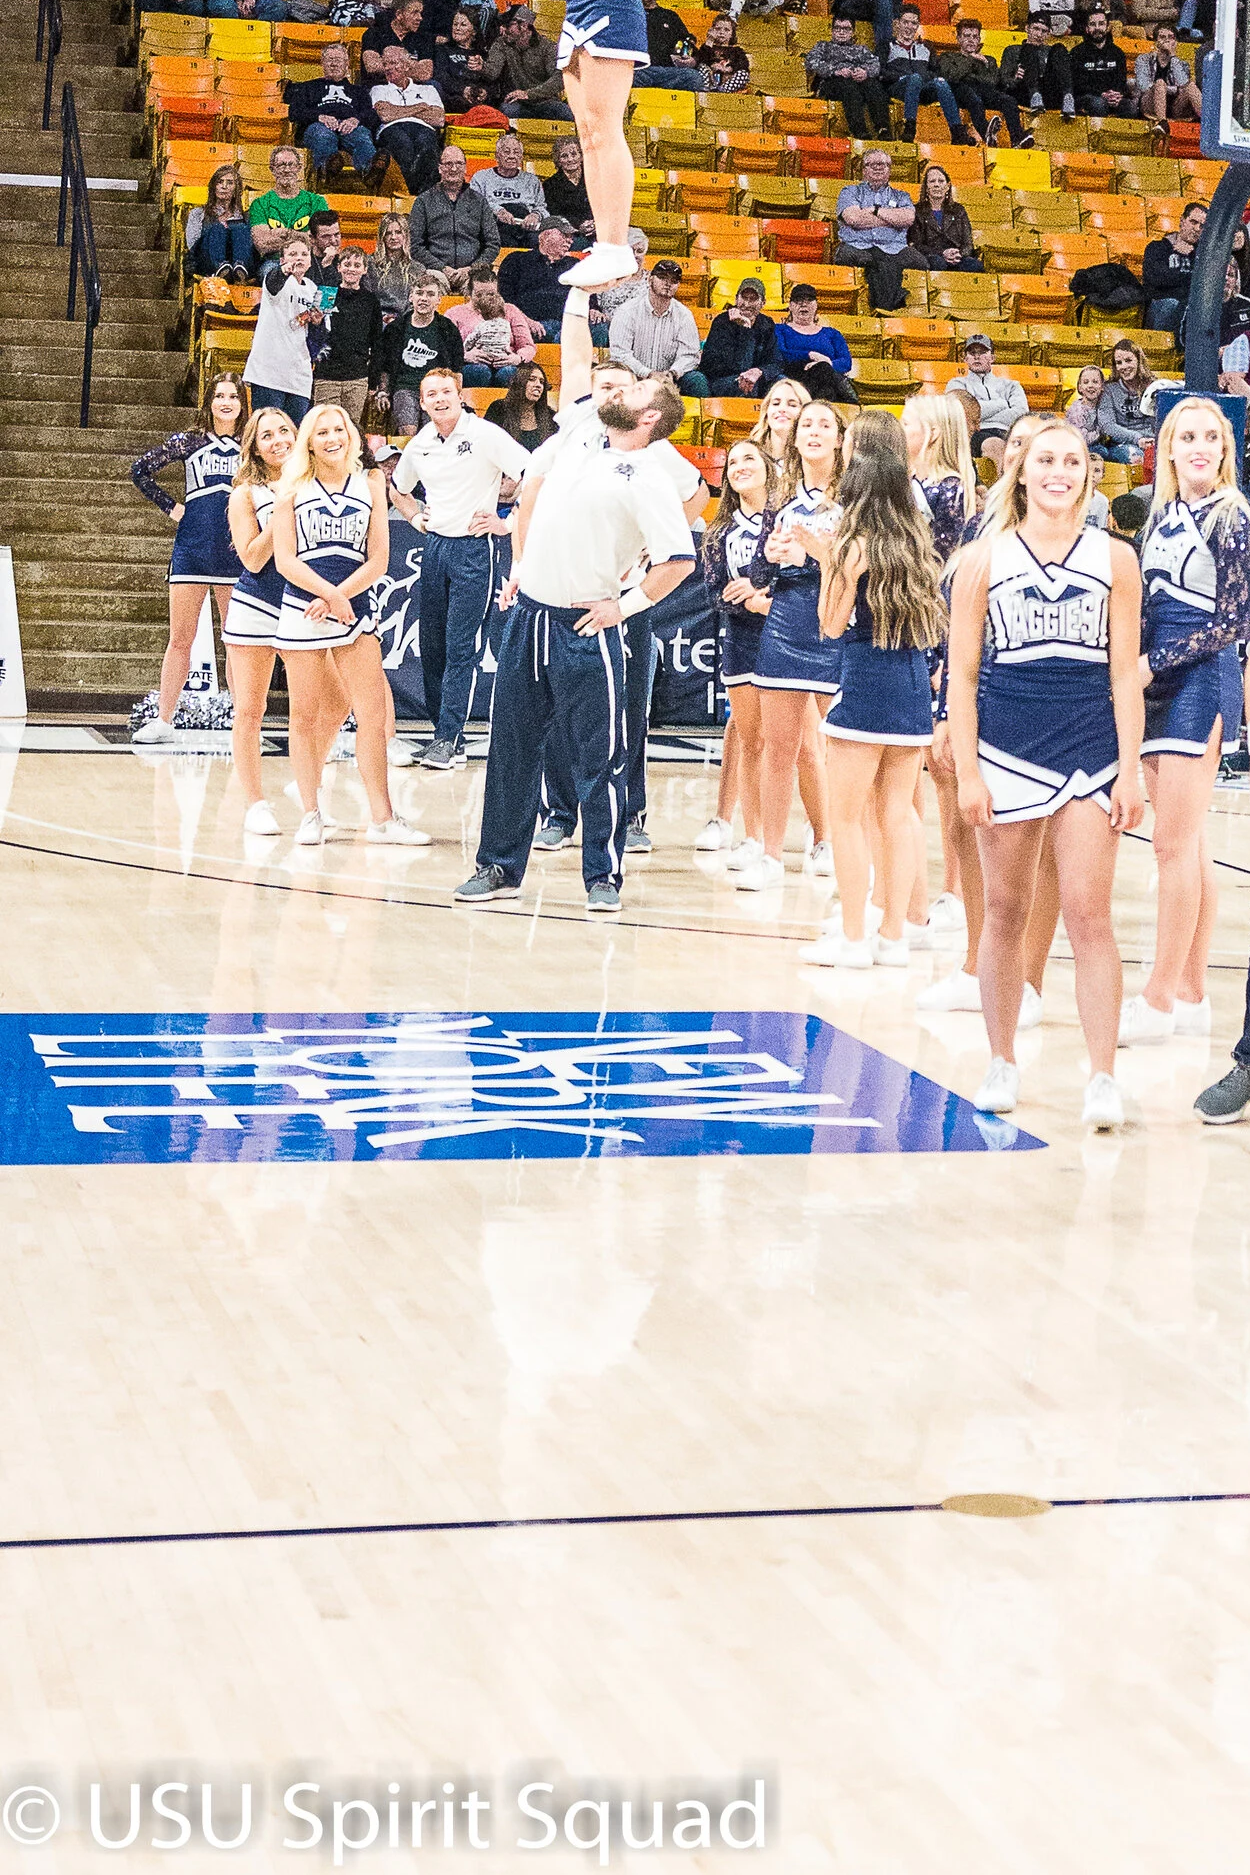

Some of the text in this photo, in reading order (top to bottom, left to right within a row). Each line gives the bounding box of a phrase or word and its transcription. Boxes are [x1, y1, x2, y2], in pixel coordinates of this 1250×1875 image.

[493, 190, 521, 200] USU
[202, 450, 241, 476] AGGIE
[308, 509, 366, 544] AGGIES
[1012, 593, 1096, 644] AGGIES
